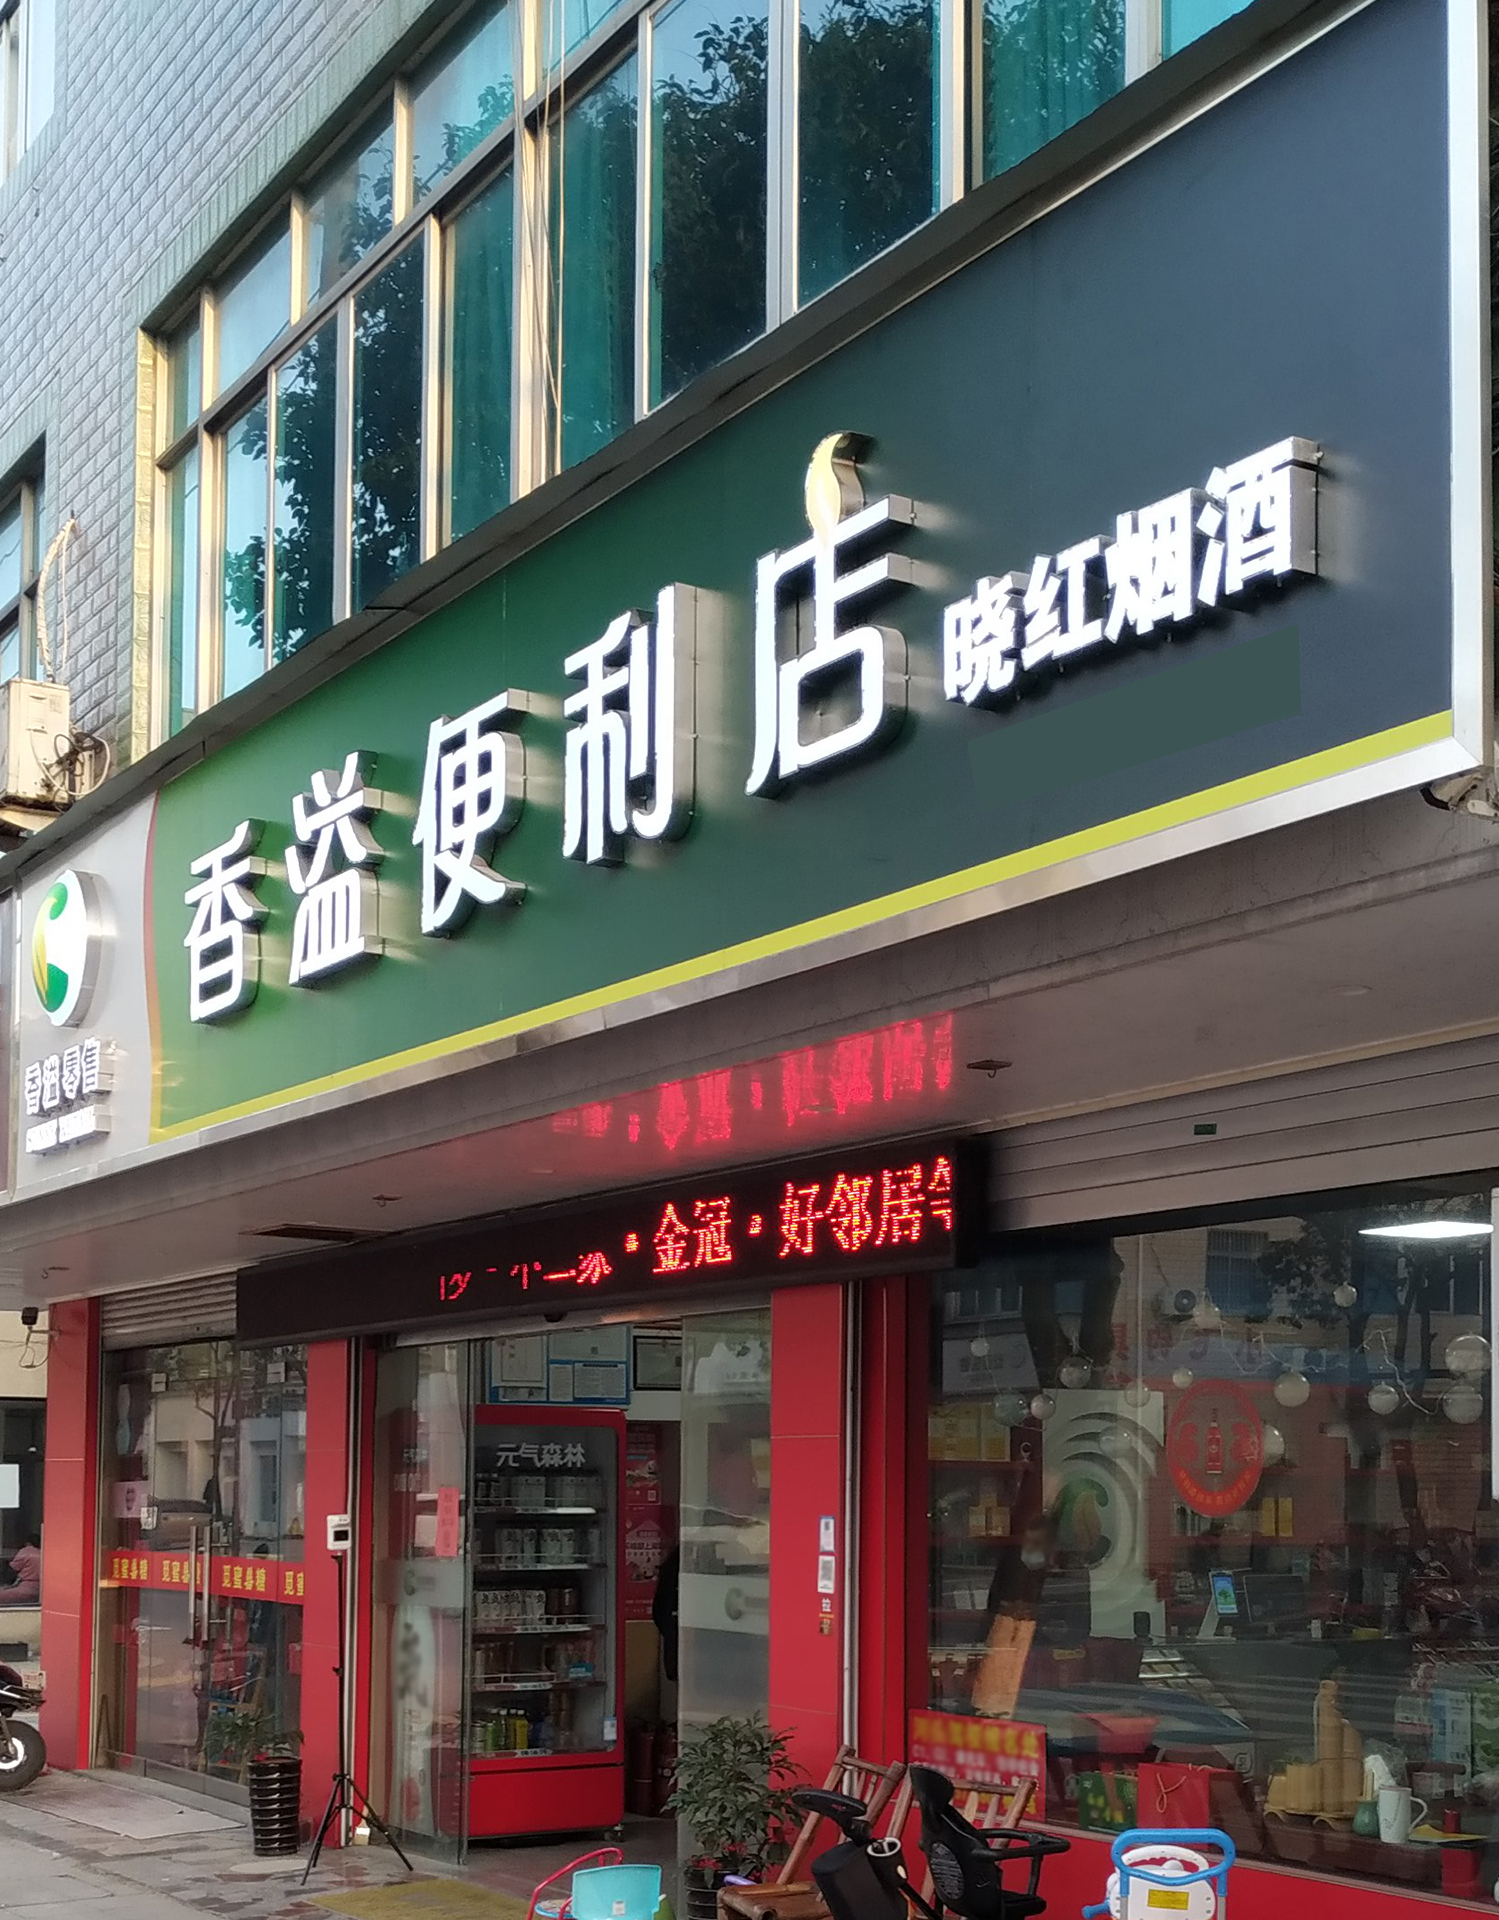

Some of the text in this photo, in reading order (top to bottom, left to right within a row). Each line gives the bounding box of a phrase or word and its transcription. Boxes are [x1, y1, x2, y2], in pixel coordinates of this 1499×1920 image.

[943, 437, 1295, 706] 晓红烟酒
[183, 431, 897, 1023] 香溢便利店
[496, 1442, 586, 1468] 元气森林
